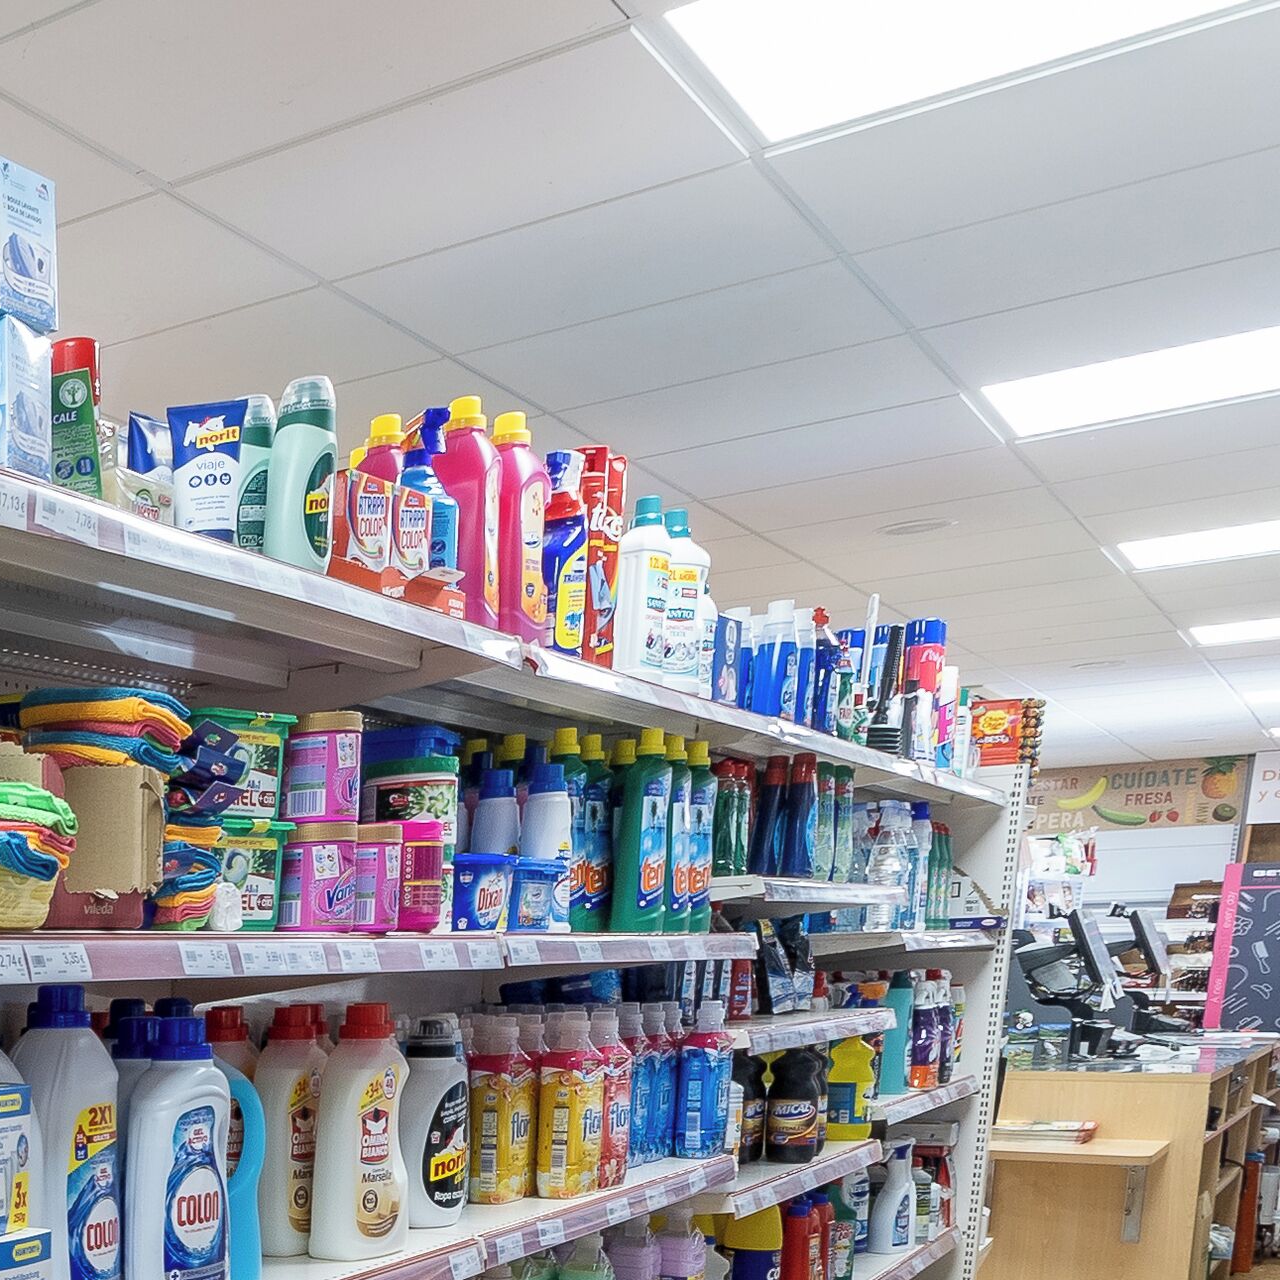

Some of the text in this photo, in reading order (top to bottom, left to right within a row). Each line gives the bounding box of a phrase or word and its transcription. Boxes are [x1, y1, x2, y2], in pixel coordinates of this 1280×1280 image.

[198, 428, 239, 446] norit
[196, 458, 226, 471] viaje
[1125, 792, 1173, 806] FRESA
[1039, 811, 1085, 830] PERA
[83, 901, 114, 915] vileda
[88, 1104, 113, 1128] 2X1
[177, 1190, 220, 1227] COLON
